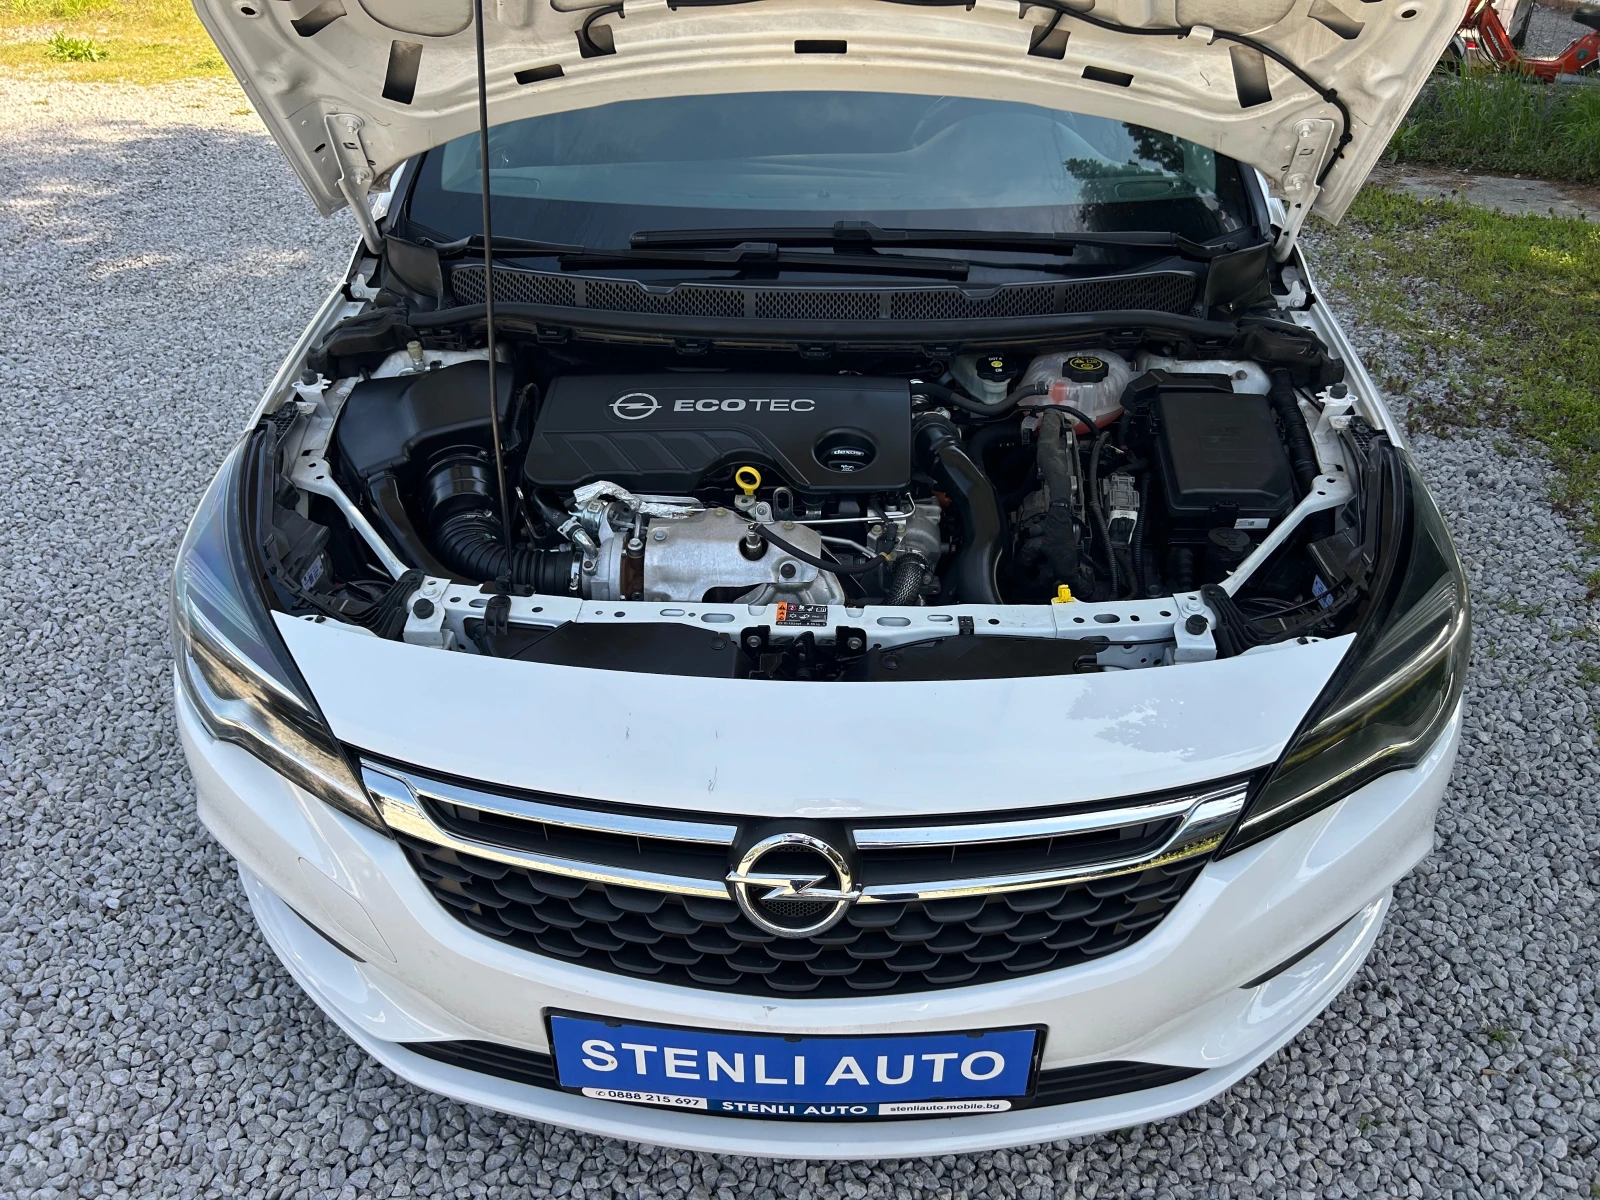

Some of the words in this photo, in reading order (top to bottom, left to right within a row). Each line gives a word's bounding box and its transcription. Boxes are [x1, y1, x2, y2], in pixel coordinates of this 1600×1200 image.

[674, 399, 816, 412] ECOTEC
[581, 1039, 805, 1086] STENLI
[825, 1051, 1005, 1086] AUTO
[608, 1090, 642, 1100] 0888
[645, 1094, 671, 1103] 215
[675, 1097, 700, 1106] 697
[722, 1101, 795, 1114] STENLI
[803, 1105, 868, 1115] AUTO
[890, 1102, 1000, 1112] stenliauto.mobile.bg
